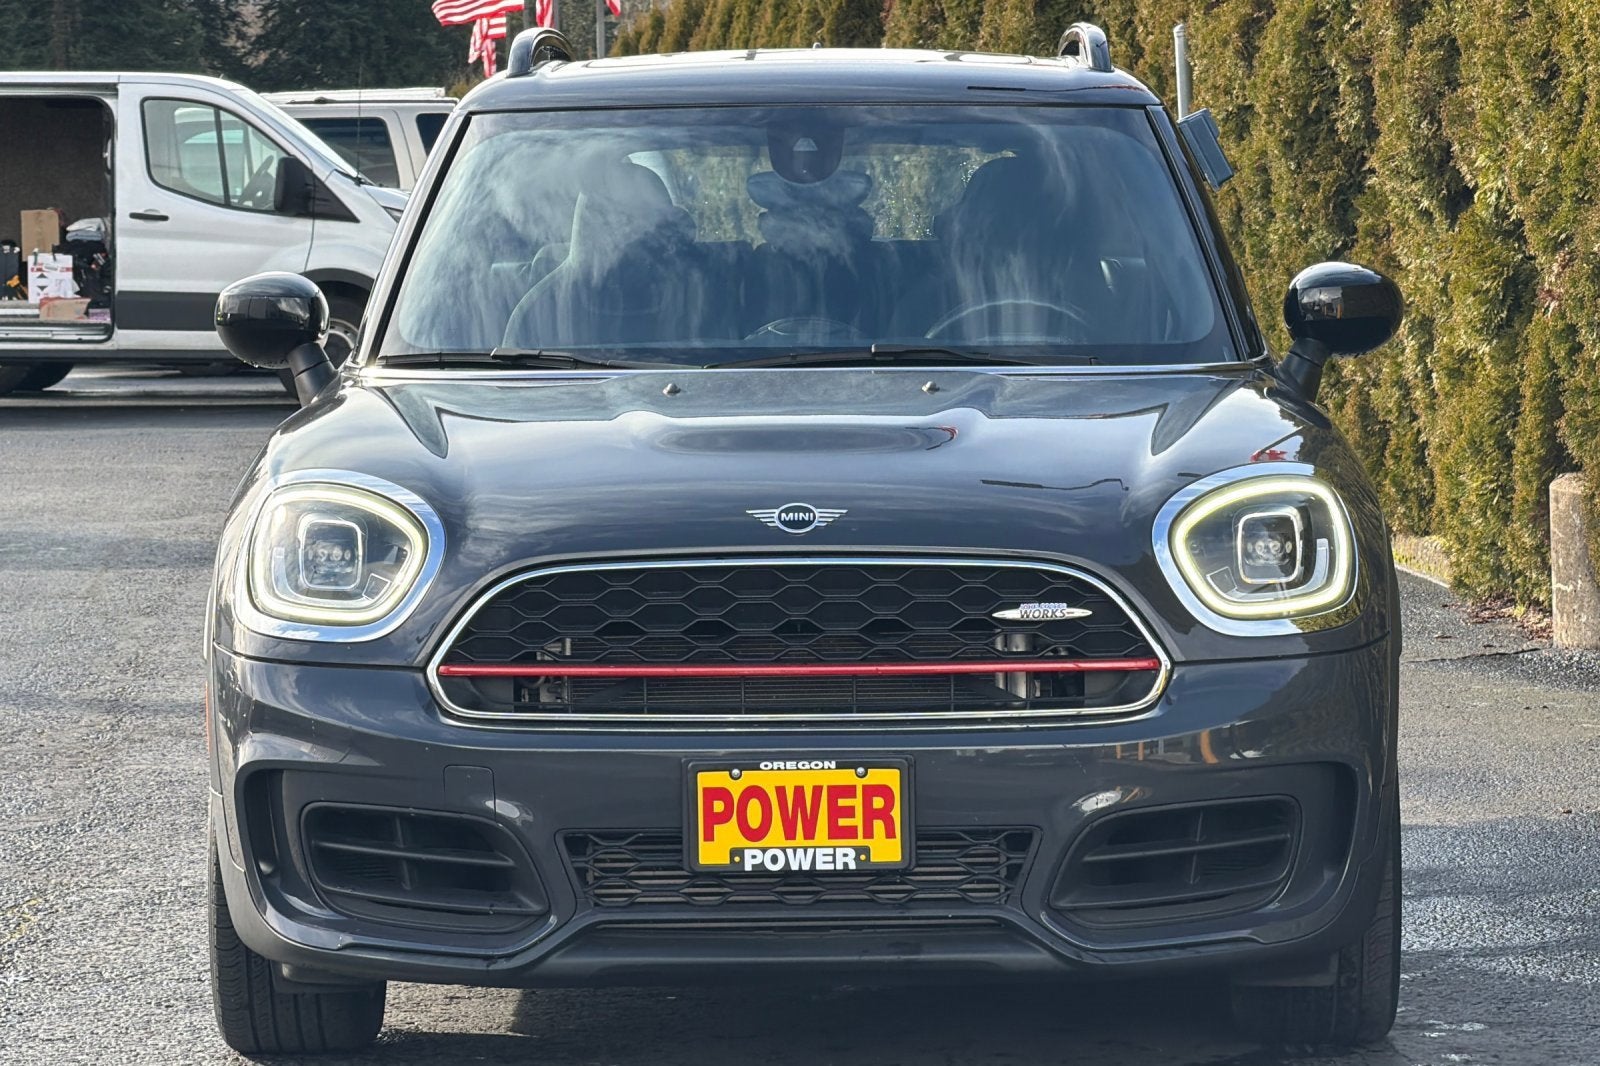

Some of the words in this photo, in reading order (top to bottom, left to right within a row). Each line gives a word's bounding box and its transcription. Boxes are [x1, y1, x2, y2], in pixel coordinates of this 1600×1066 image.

[780, 512, 814, 521] MINI
[1020, 609, 1066, 619] WORKS
[759, 761, 837, 770] OREGON
[702, 784, 897, 842] POWER
[744, 847, 857, 871] POWER
